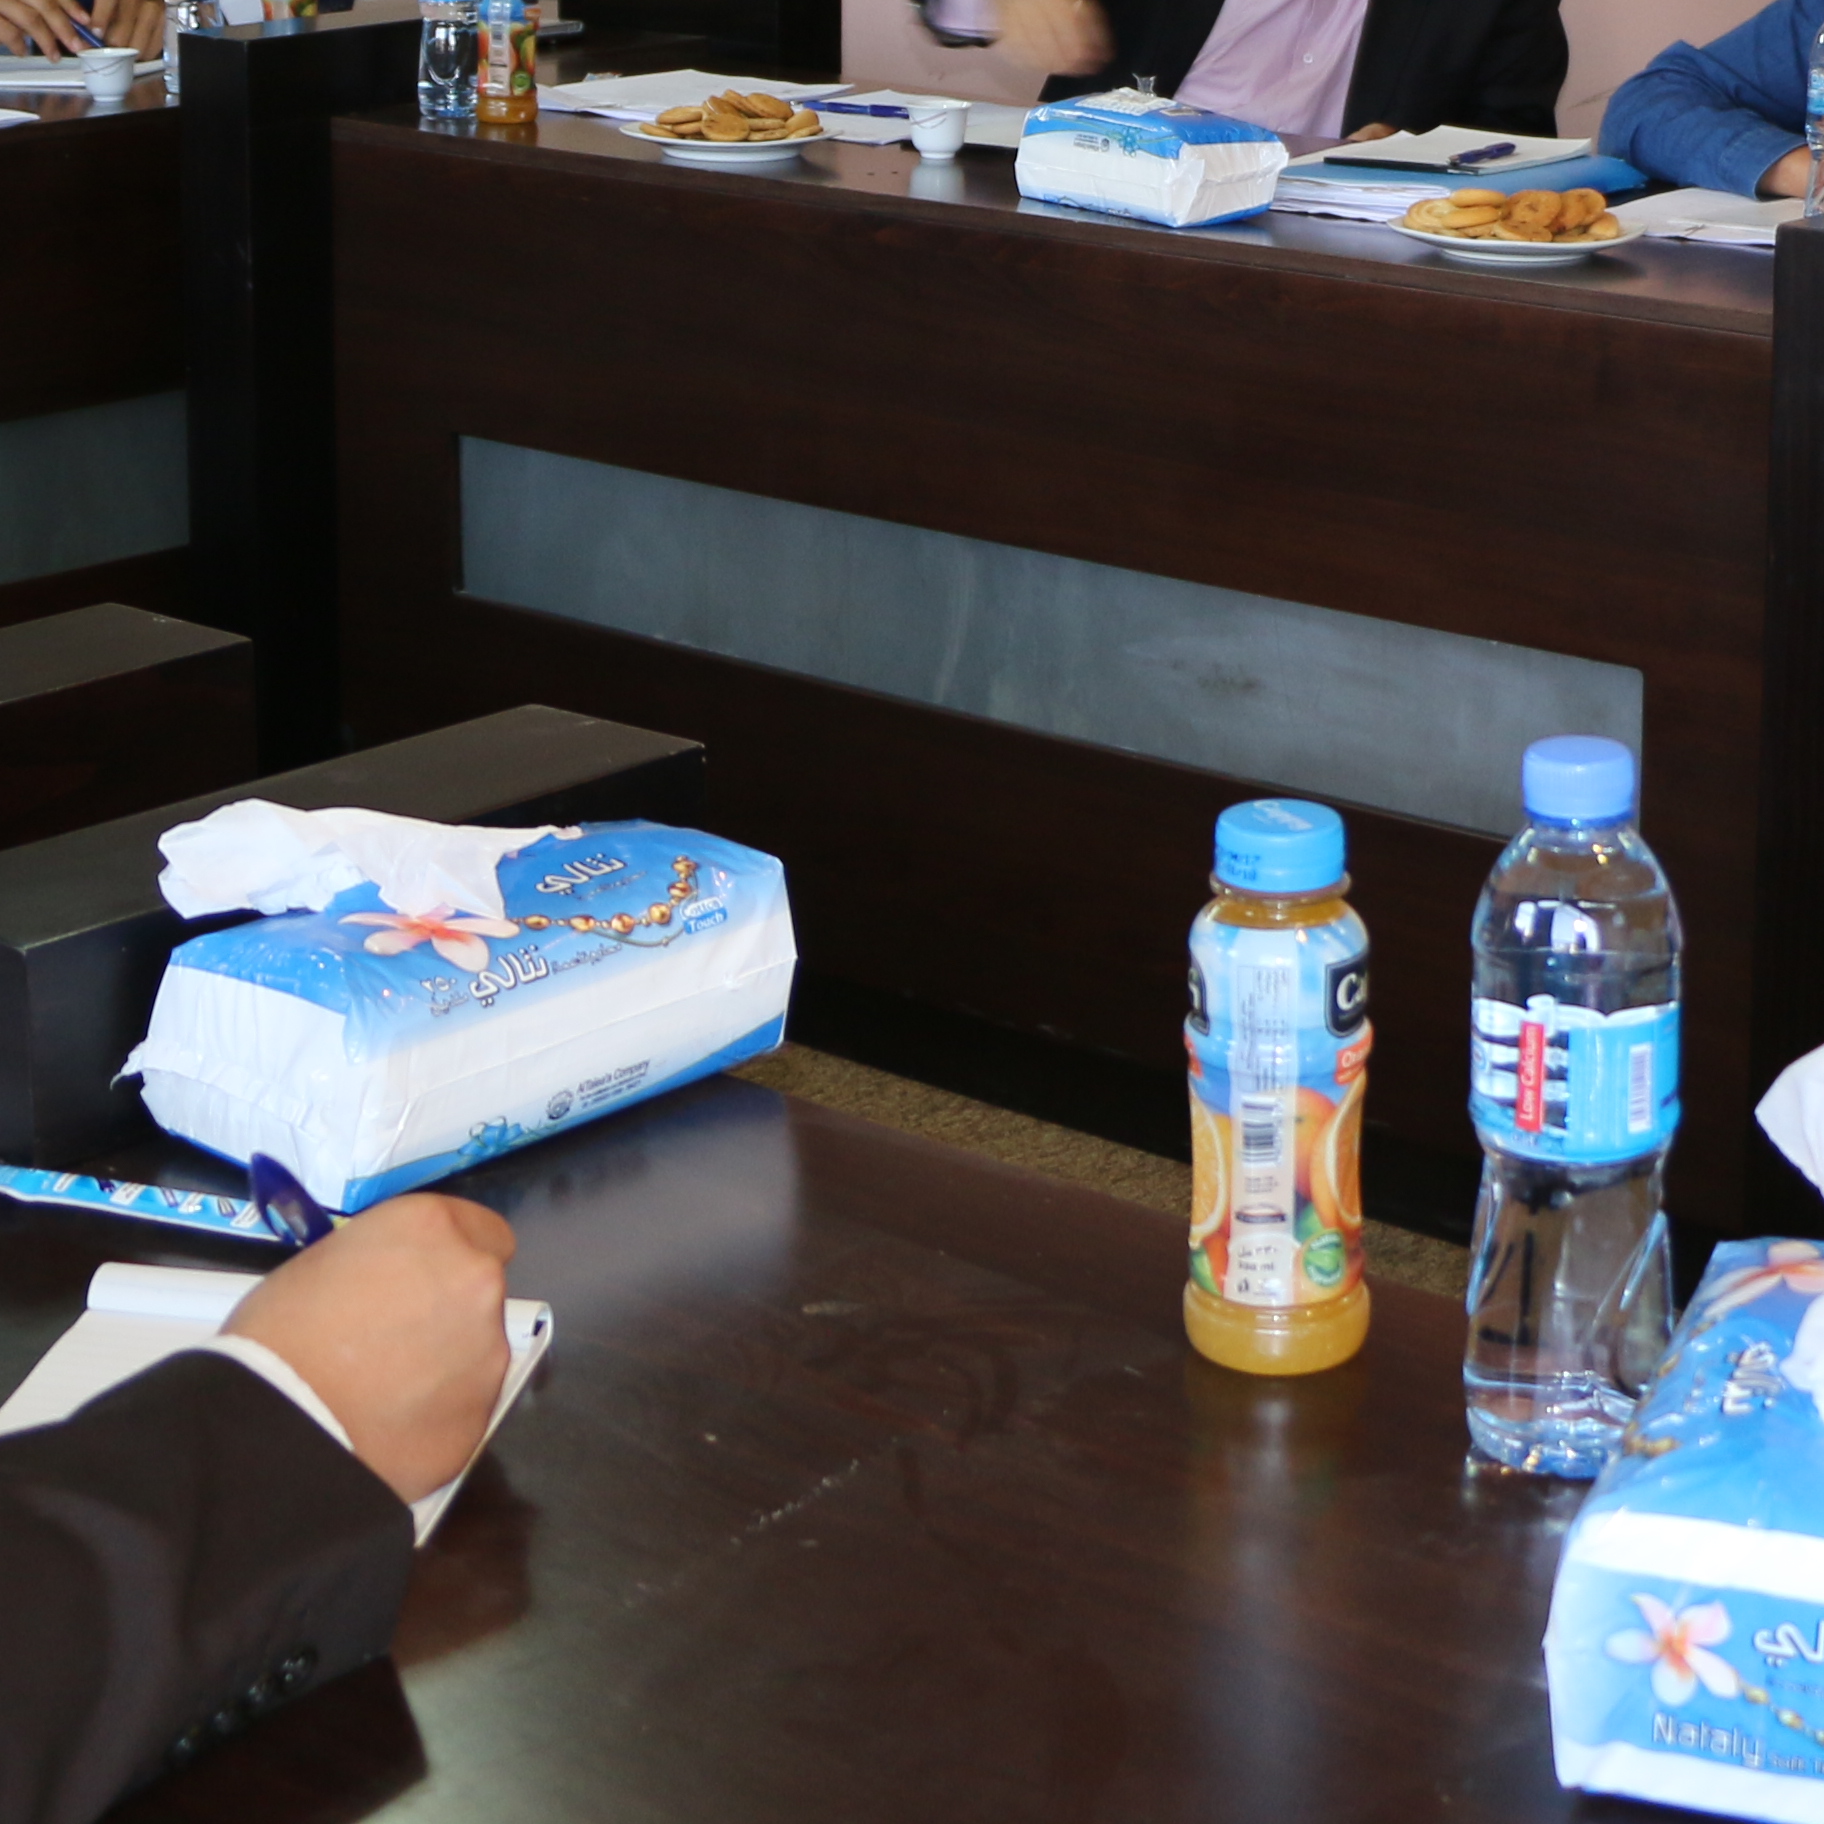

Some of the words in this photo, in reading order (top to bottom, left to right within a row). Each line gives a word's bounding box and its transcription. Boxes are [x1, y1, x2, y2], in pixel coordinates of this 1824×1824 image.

[535, 852, 628, 896] نتالي
[687, 912, 725, 933] Touch
[468, 944, 549, 1009] نتالي
[1652, 1712, 1762, 1770] Nataly
